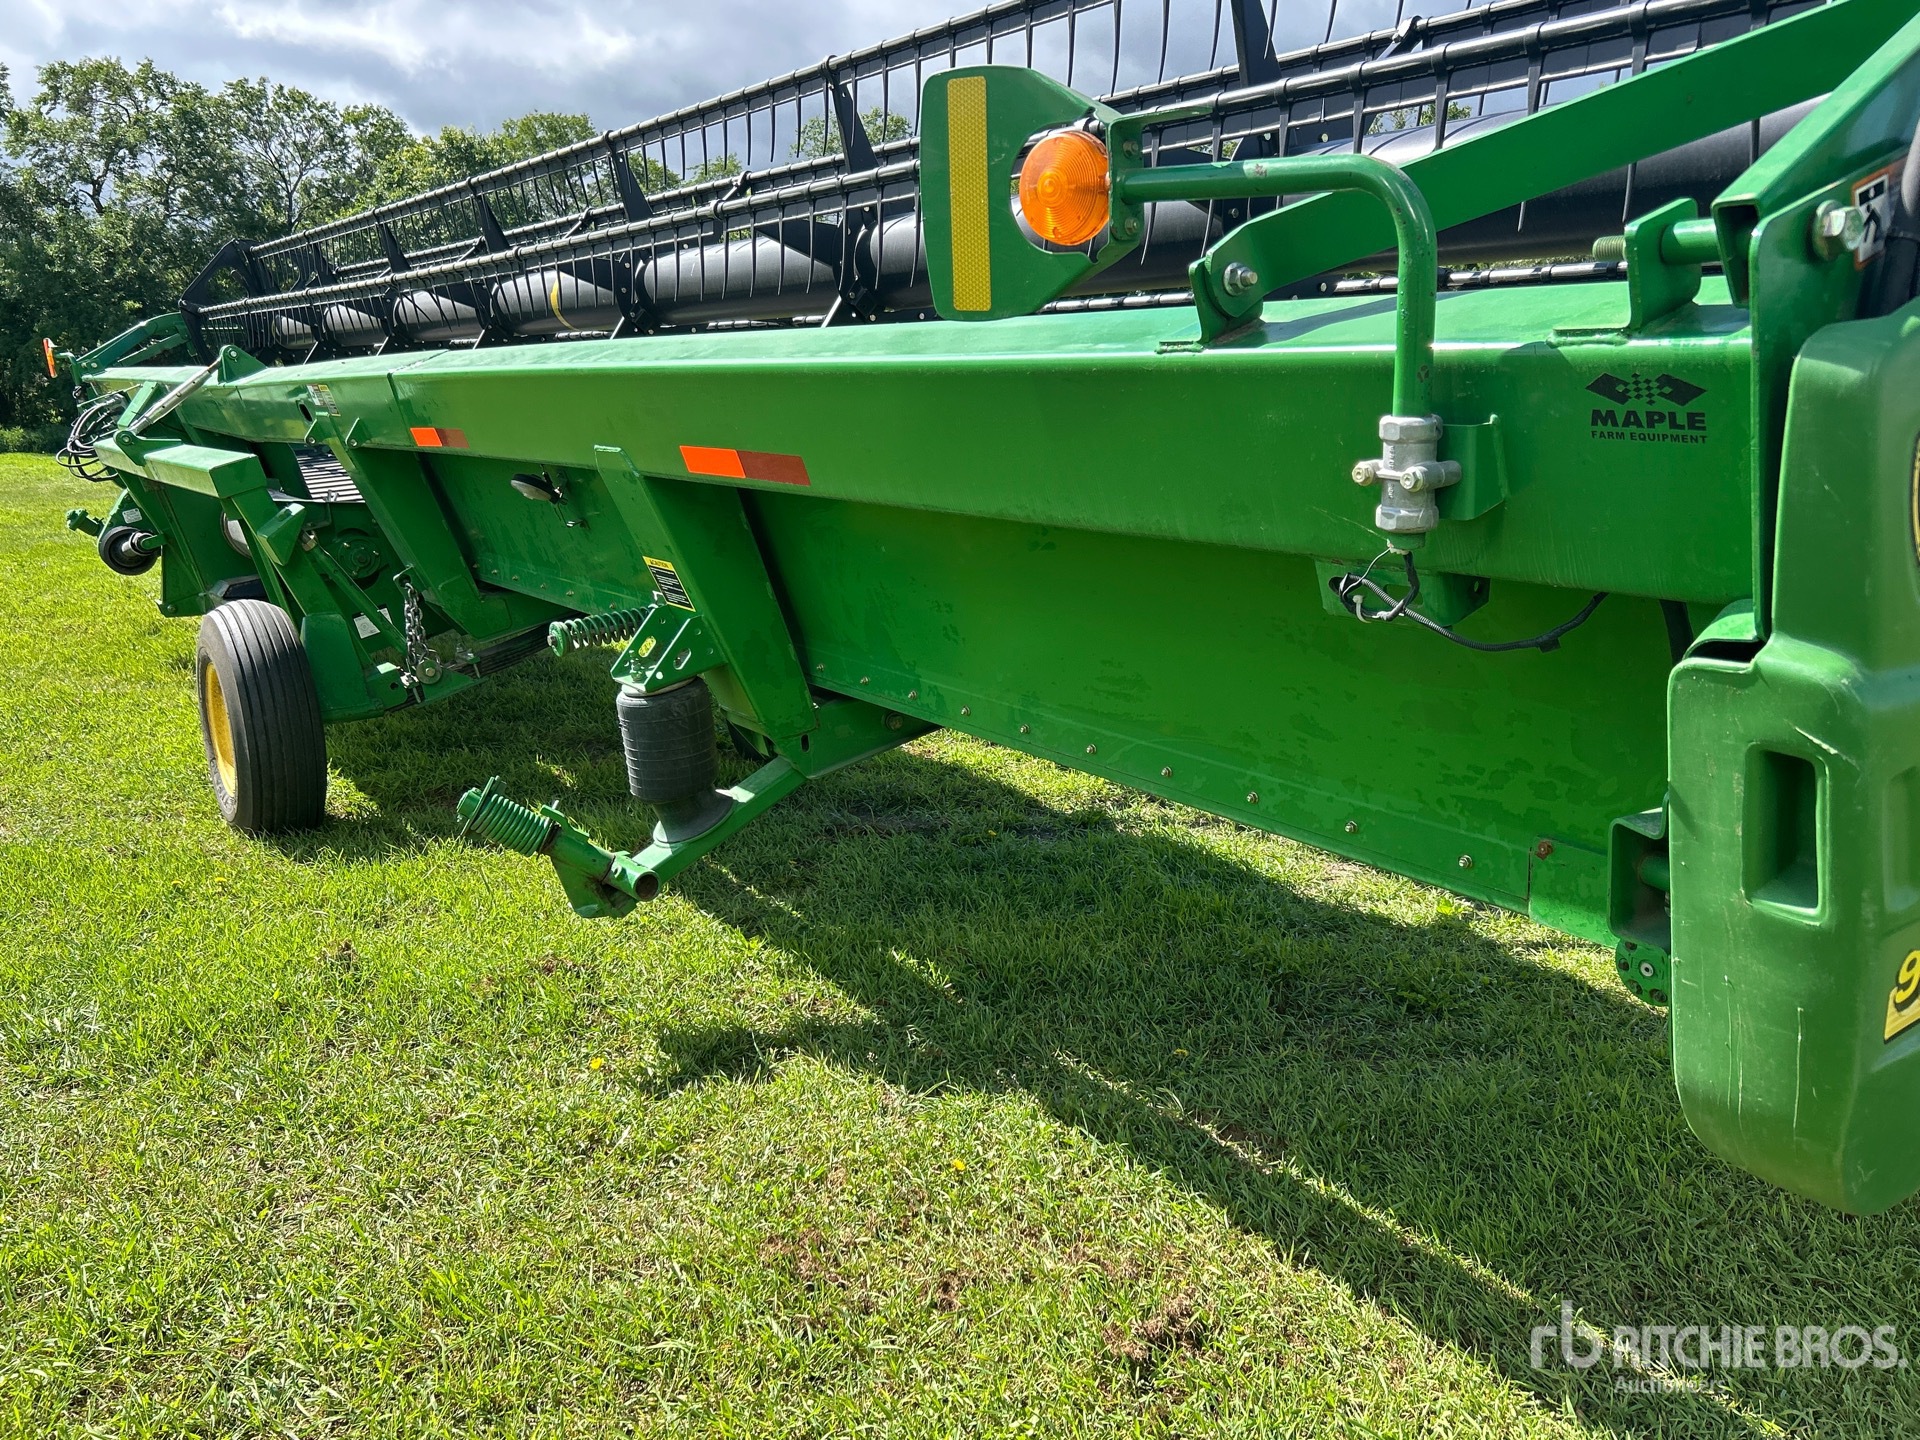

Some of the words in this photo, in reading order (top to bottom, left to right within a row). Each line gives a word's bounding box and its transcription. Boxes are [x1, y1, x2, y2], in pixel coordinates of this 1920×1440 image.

[1591, 409, 1707, 431] MAPLE
[1591, 430, 1625, 440] FARM
[1630, 432, 1708, 444] EQUIPMENT
